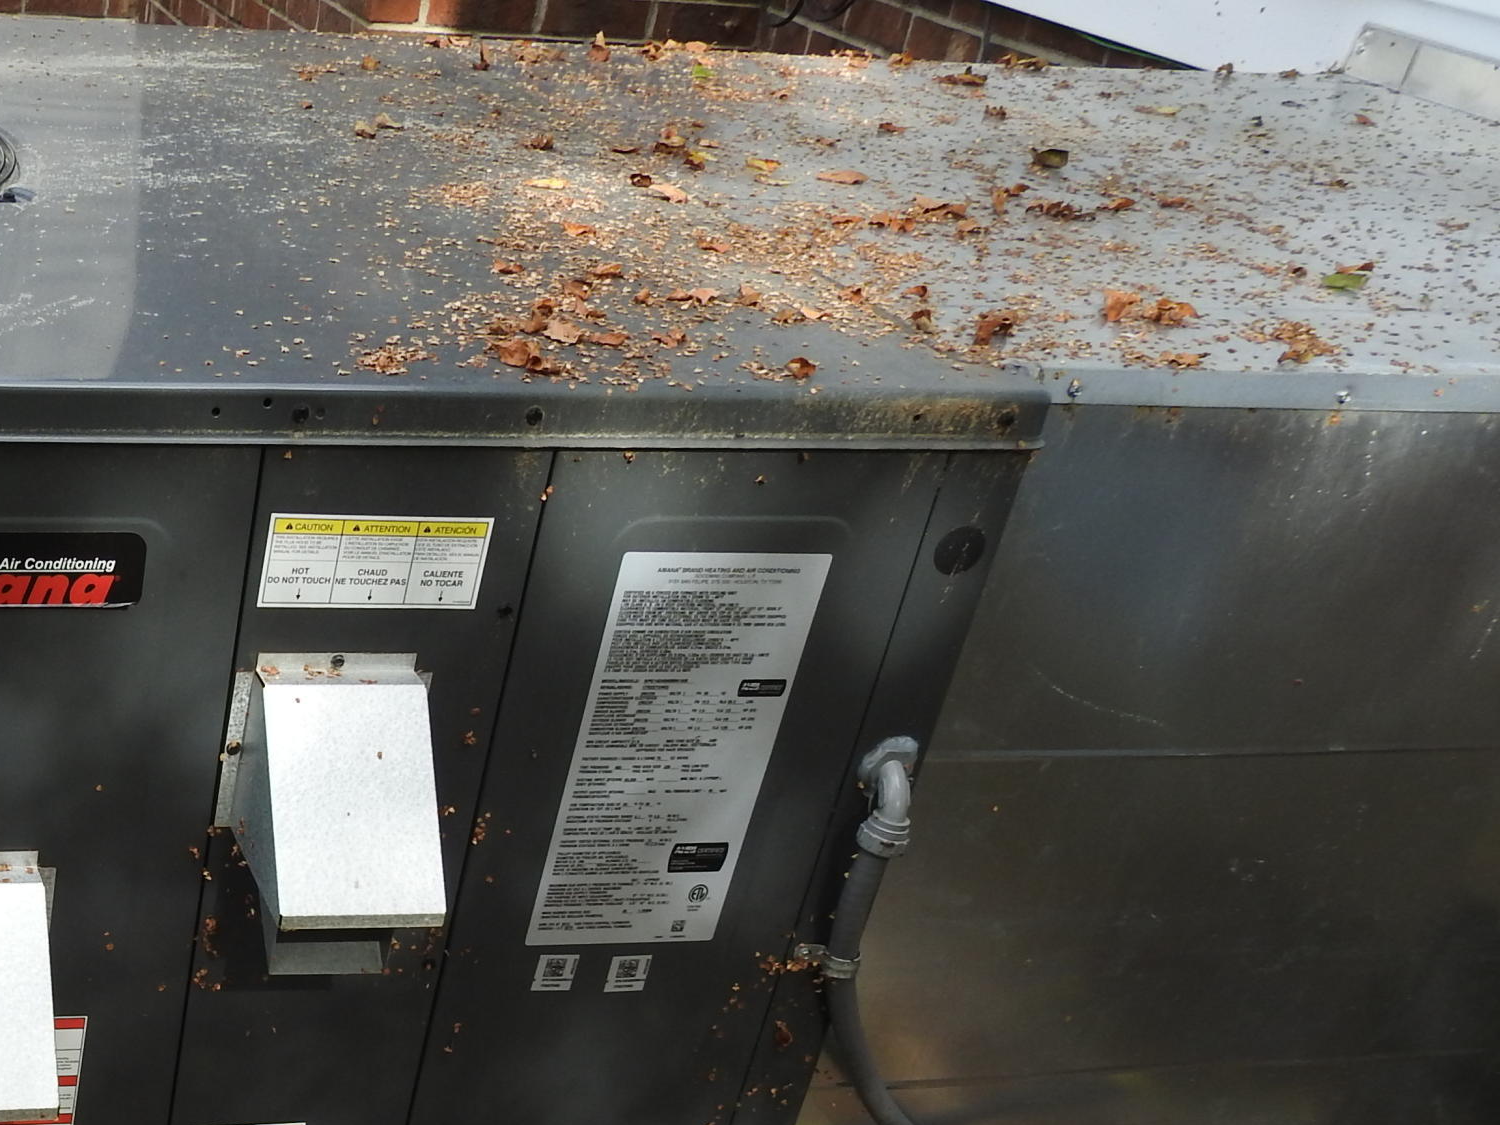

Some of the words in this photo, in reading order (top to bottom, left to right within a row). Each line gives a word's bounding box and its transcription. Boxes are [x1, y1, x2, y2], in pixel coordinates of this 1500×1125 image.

[364, 525, 411, 533] ATTENTION
[434, 526, 477, 535] ATENCIÓN
[0, 558, 21, 570] Air
[24, 558, 116, 572] Conditioning
